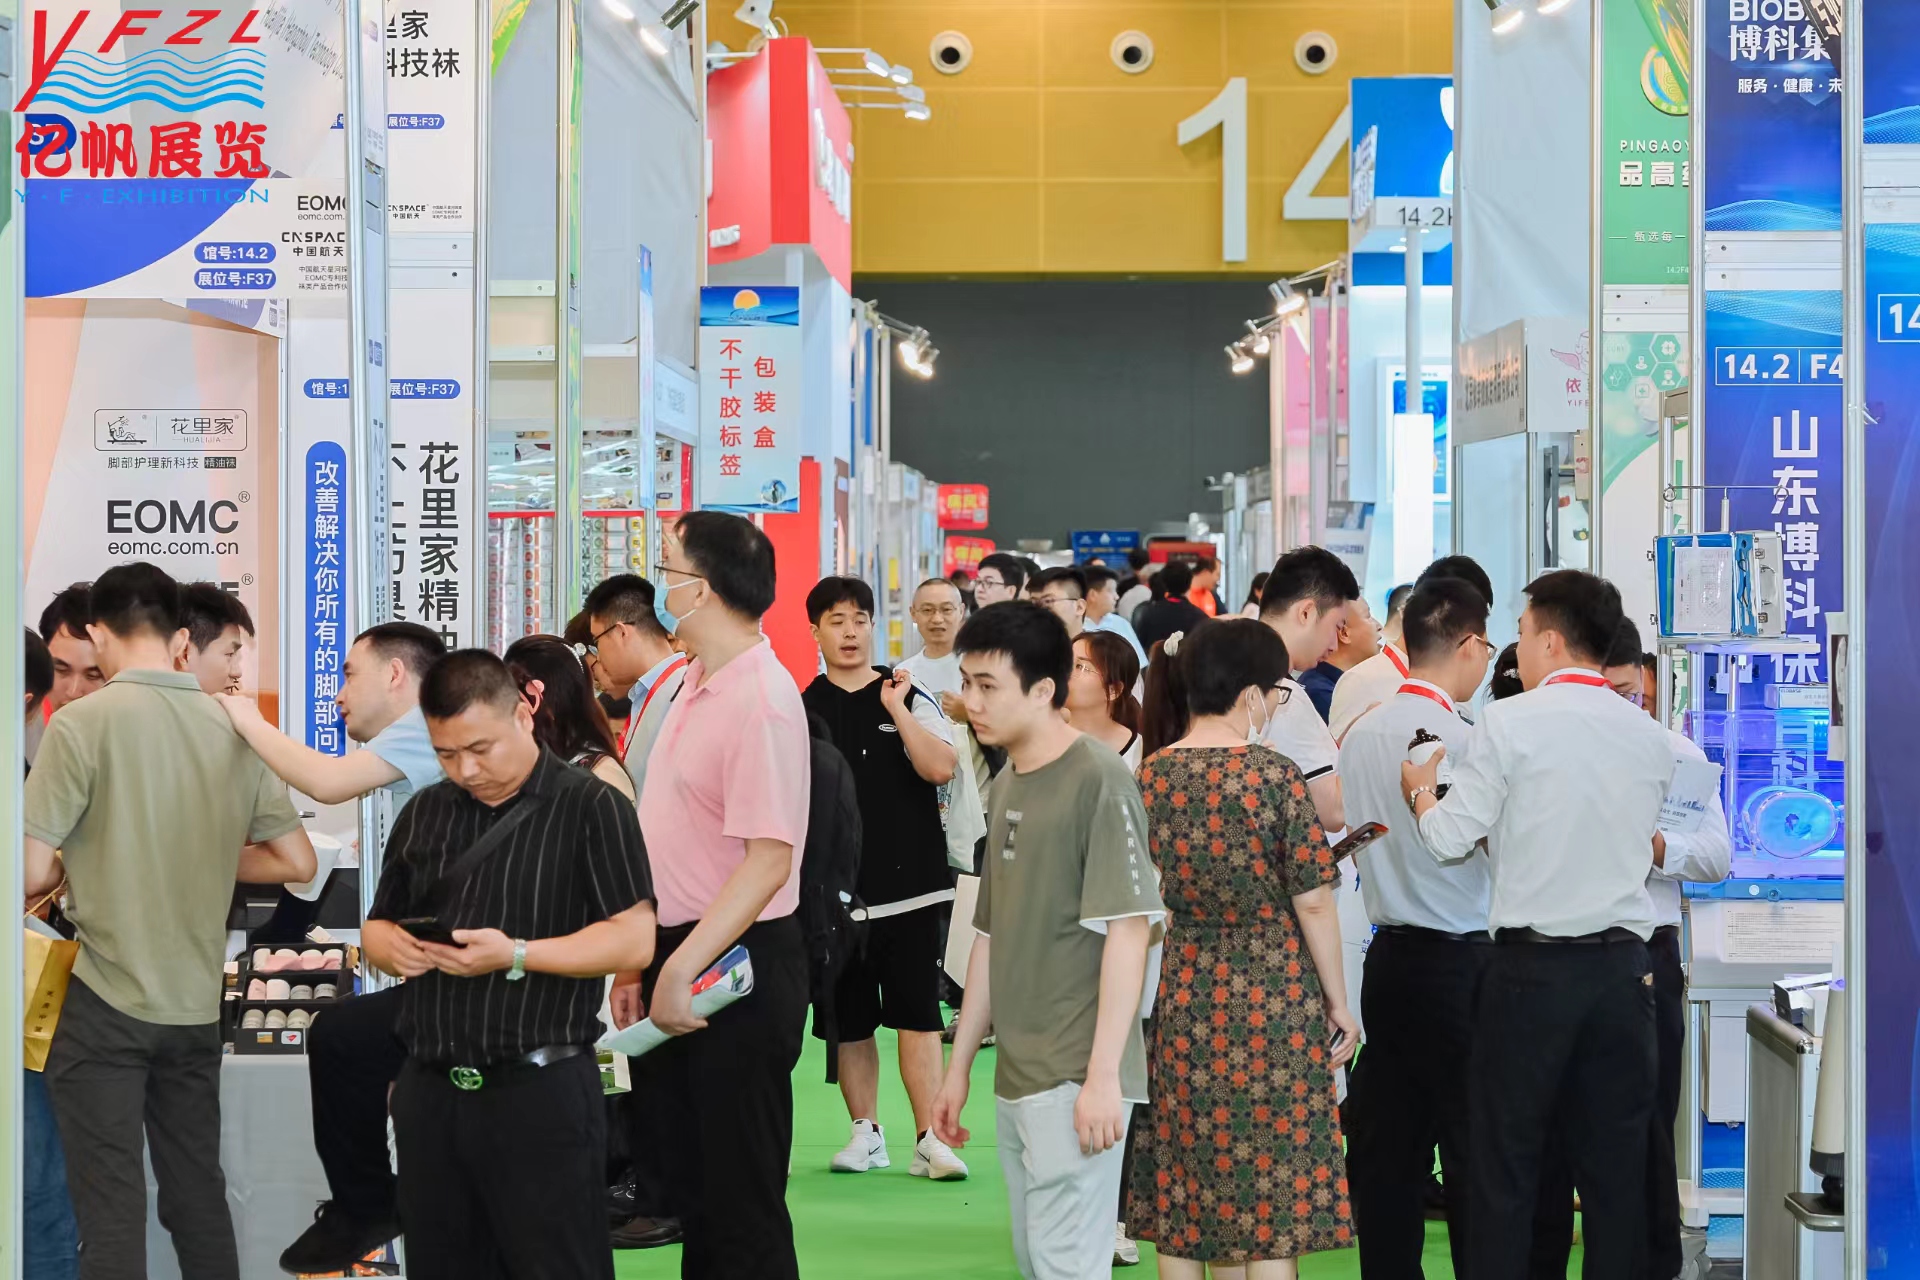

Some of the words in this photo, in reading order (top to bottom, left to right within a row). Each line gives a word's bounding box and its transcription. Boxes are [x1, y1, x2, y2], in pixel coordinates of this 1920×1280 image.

[1729, 0, 1812, 21] BIOB
[1728, 24, 1831, 61] 博科集
[202, 246, 269, 260] 馆号:14.2
[292, 246, 344, 257] 中国航天
[198, 272, 273, 286] 展位号:F37
[1724, 354, 1790, 379] 14.2
[719, 339, 742, 476] 不干胶标签
[754, 356, 776, 448] 包装盒
[170, 417, 233, 435] 花里家
[107, 456, 200, 469] 脚部护理新科技
[107, 500, 239, 534] EOMC
[108, 541, 239, 555] eomc.com.cn
[314, 461, 340, 757] 改善解决你所有的脚部问
